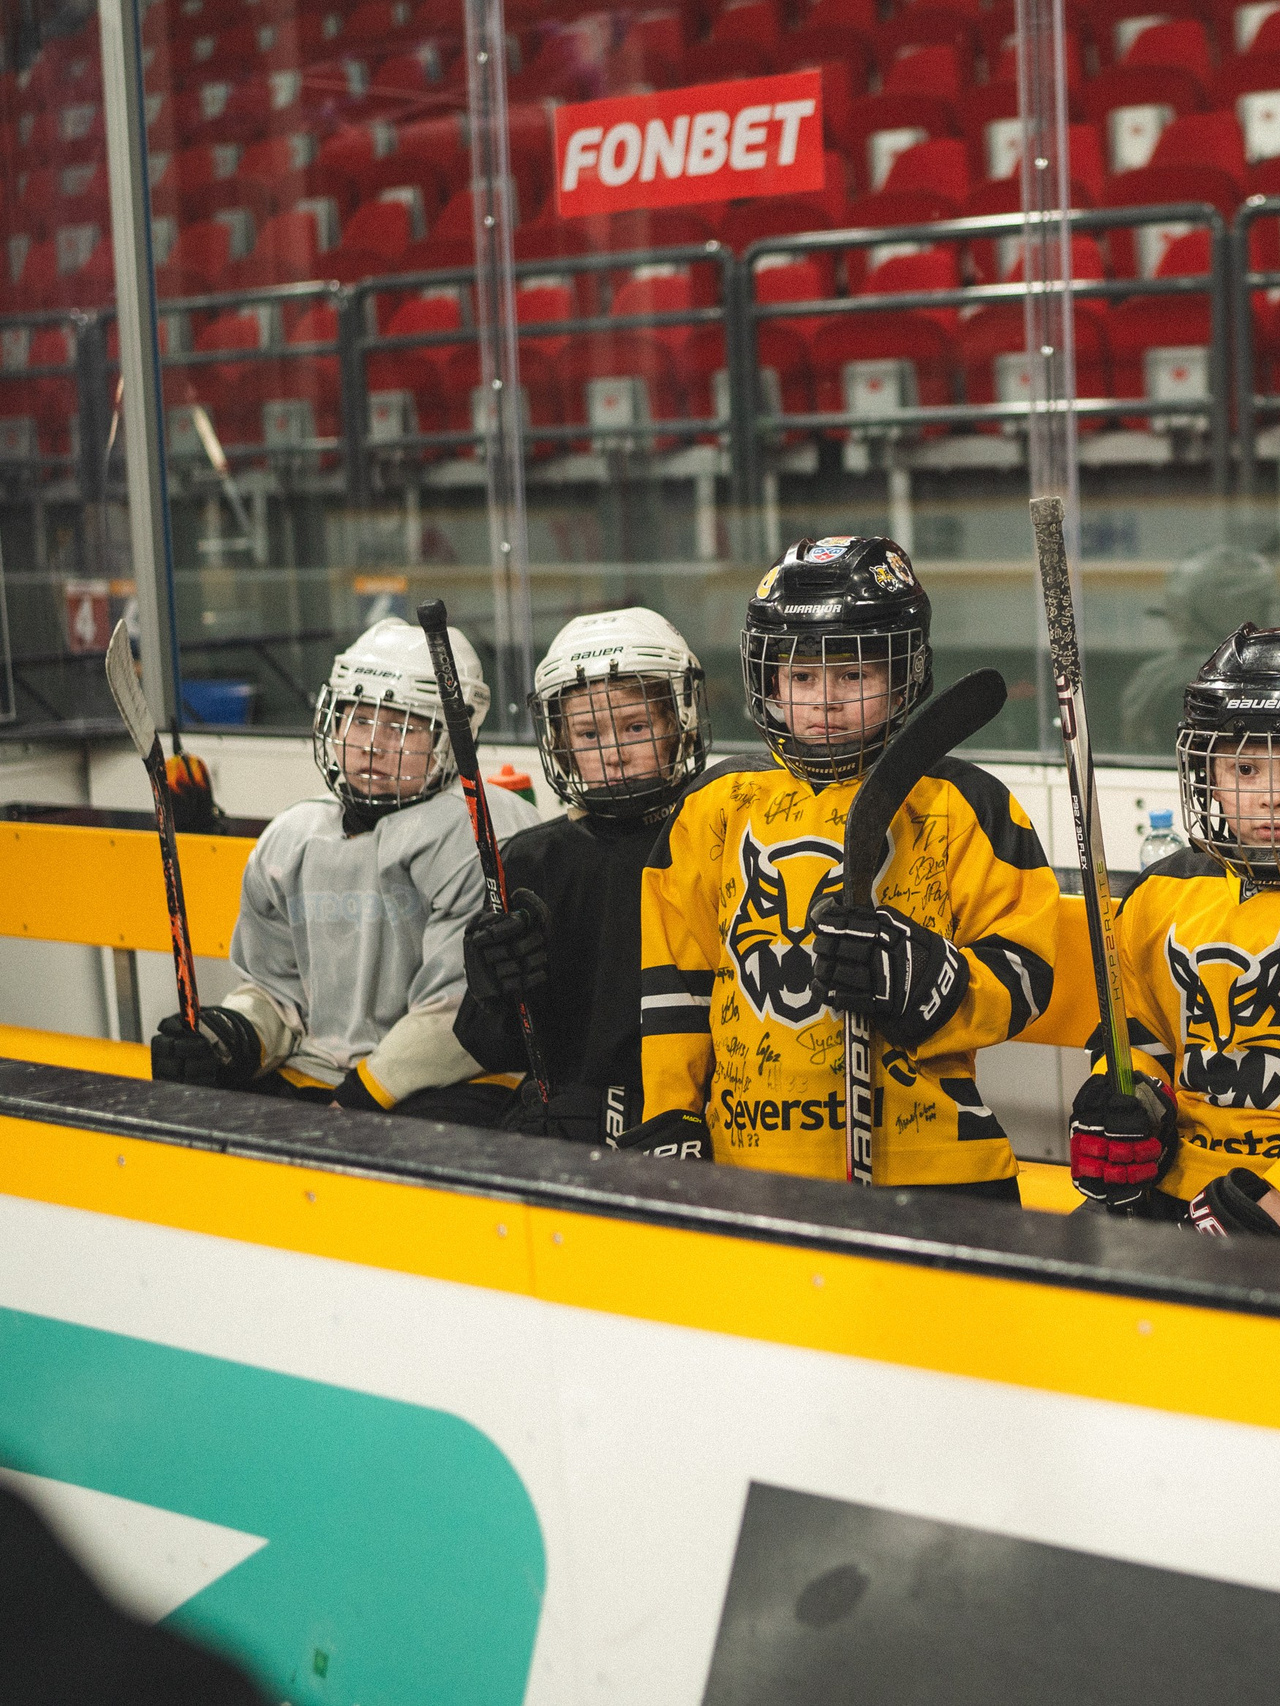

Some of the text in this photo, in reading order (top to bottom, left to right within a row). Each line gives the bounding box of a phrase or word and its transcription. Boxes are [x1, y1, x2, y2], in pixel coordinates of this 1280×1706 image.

[562, 99, 816, 192] FONBET
[784, 604, 842, 613] WARRIOR
[571, 646, 624, 661] BAUER
[1078, 843, 1088, 870] FLEX
[720, 1086, 885, 1131] Severstl
